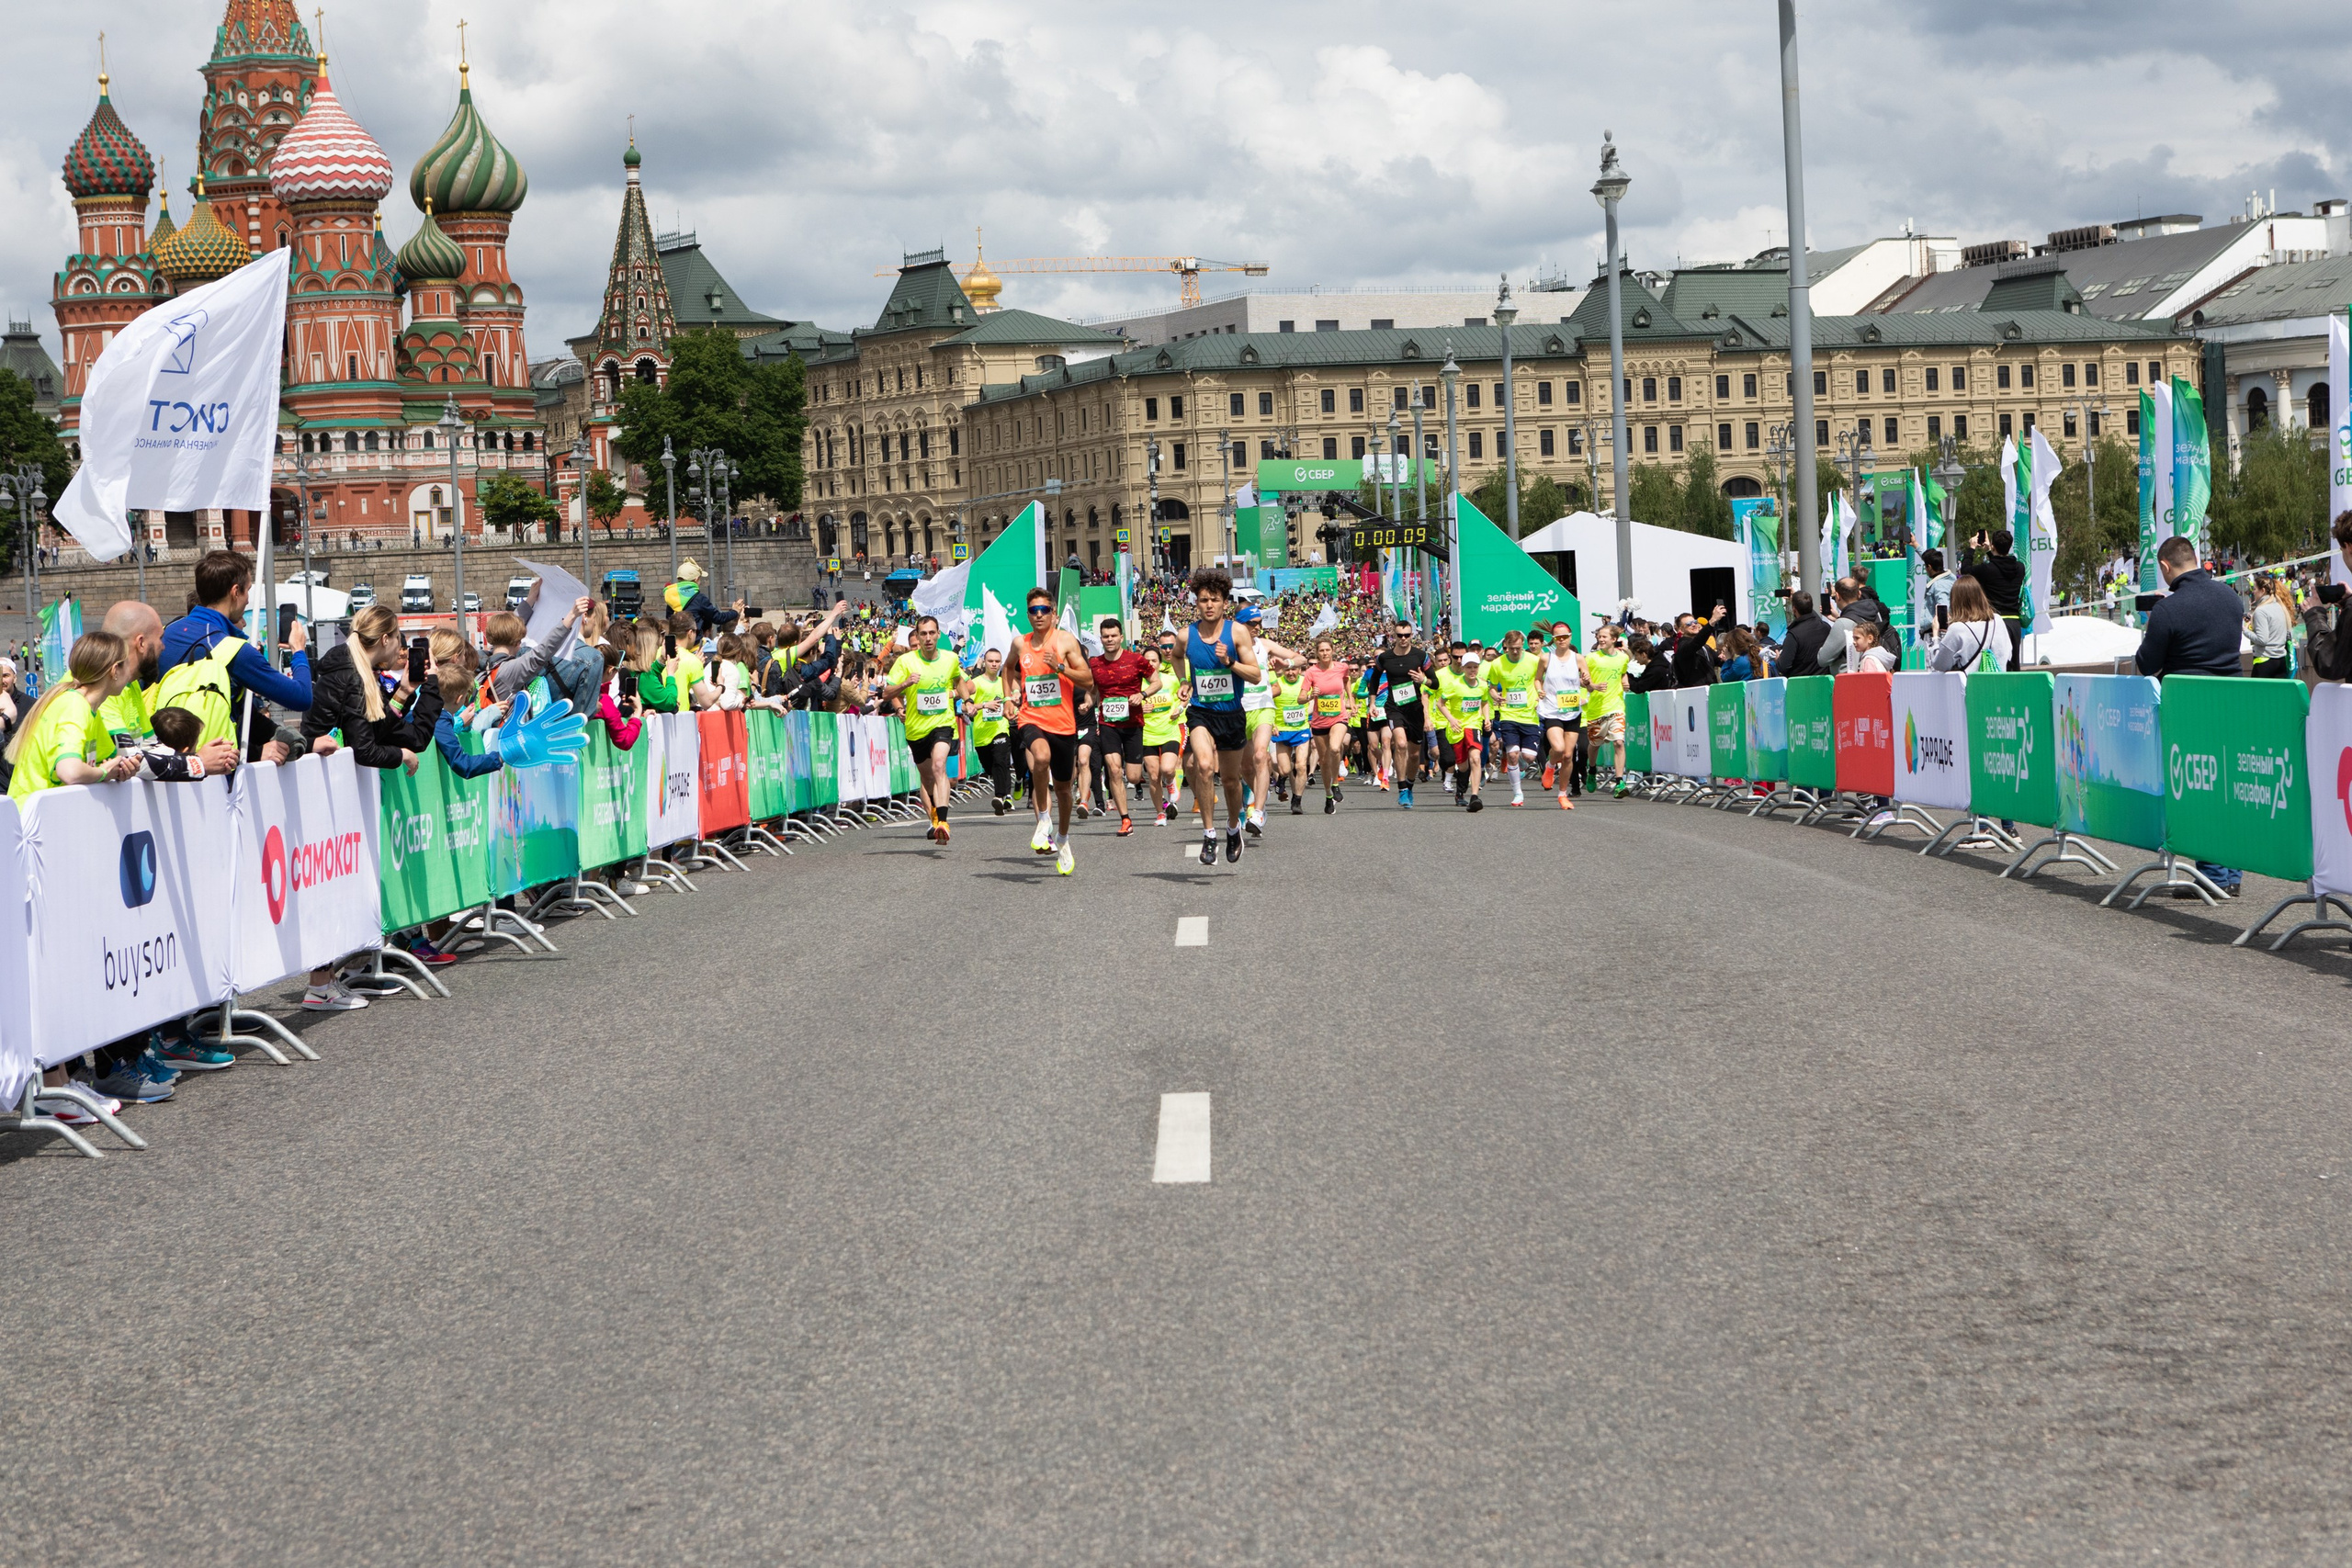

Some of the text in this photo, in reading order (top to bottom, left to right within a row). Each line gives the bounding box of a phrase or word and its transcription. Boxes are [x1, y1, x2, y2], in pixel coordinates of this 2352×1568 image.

[1308, 469, 1334, 480] СБЕР
[1481, 602, 1530, 613] марафон
[1487, 591, 1534, 602] зелёный
[1030, 682, 1056, 694] 4352
[1201, 678, 1227, 689] 4670
[923, 695, 941, 705] 906
[1105, 705, 1125, 713] 2259
[1985, 706, 2017, 739] зелёный
[1920, 736, 1953, 773] ЗАРЯДЬЕ
[1984, 742, 2016, 783] марафон
[2237, 746, 2274, 775] зелёный
[2185, 753, 2217, 791] СБЕР
[2233, 776, 2271, 809] марафон
[406, 813, 433, 854] СБЕР
[103, 931, 176, 998] buyson
